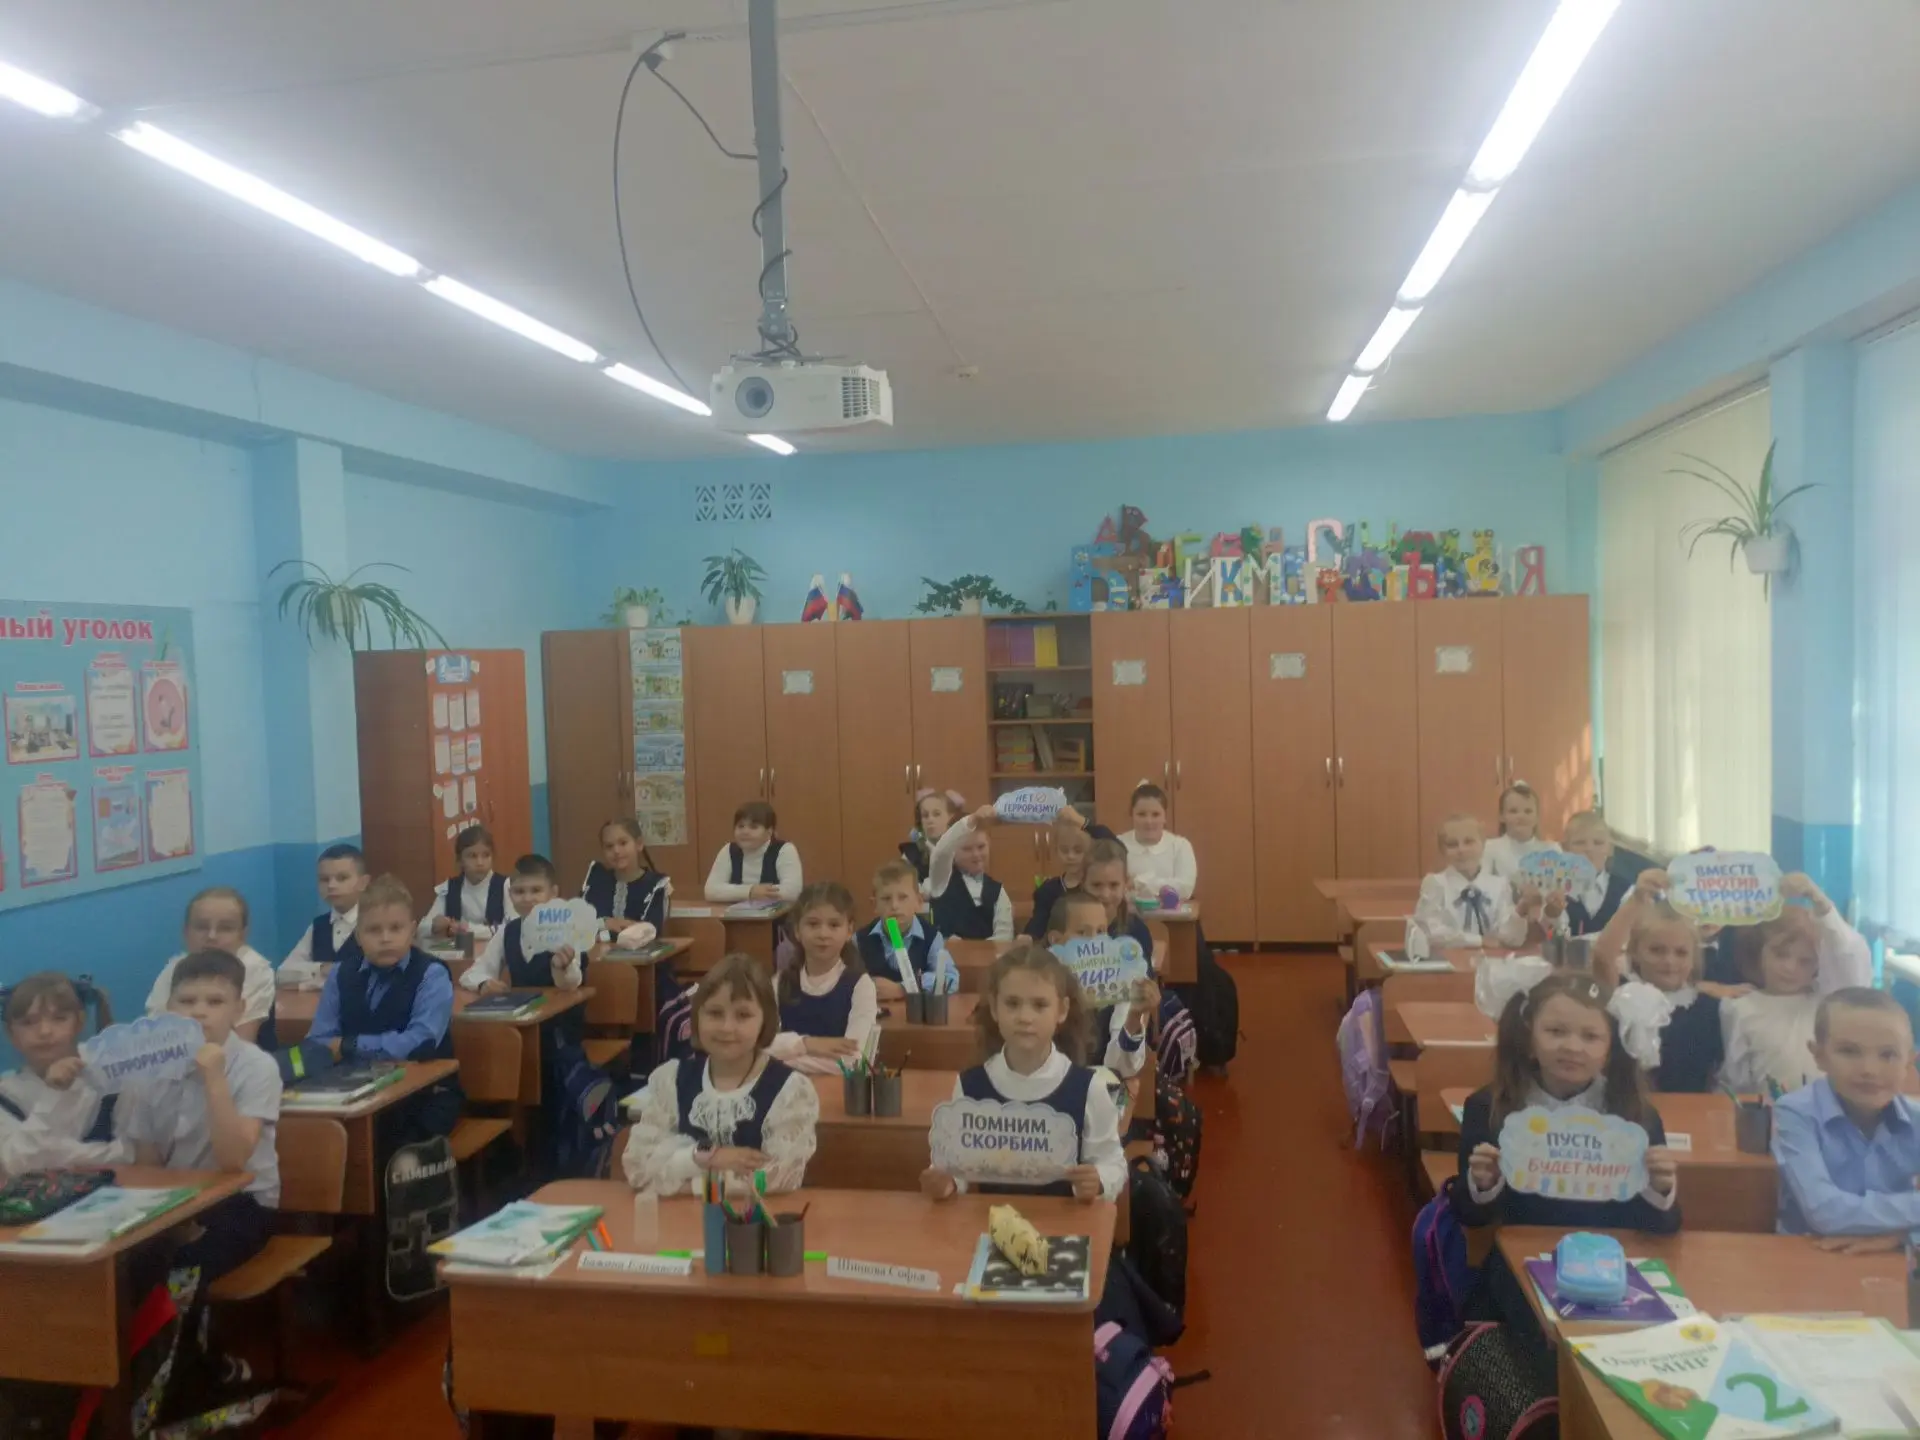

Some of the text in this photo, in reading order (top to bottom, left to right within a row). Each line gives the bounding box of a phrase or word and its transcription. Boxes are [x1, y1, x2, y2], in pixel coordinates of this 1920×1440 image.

[62, 619, 152, 646] уголок
[1695, 864, 1755, 877] ВМЕСТЕ
[1077, 941, 1104, 958] МЫ
[961, 1112, 1051, 1135] ПОМНИМ.
[961, 1132, 1053, 1153] СКОРБИМ.
[1546, 1132, 1602, 1149] ПУСТЬ
[1528, 1157, 1582, 1175] БУДЕТ
[1725, 1372, 1810, 1422] 2
